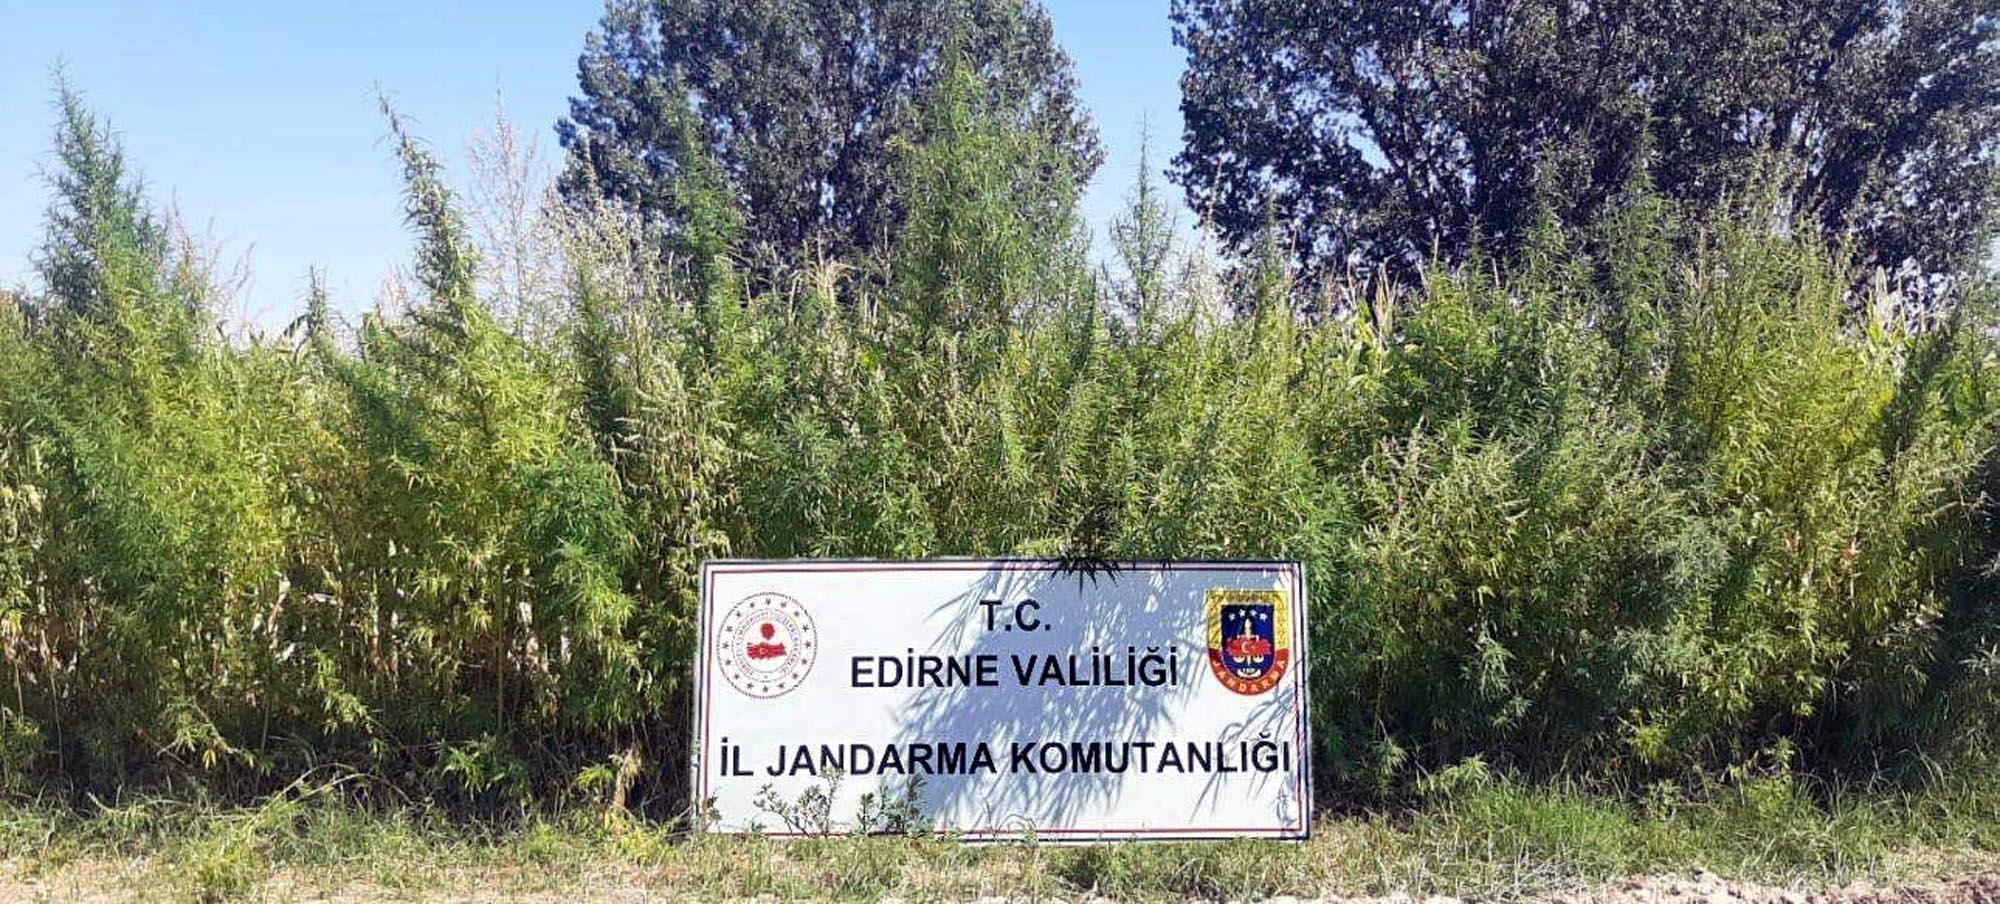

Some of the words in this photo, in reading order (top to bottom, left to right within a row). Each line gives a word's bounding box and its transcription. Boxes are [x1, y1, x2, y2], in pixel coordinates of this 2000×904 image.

[979, 599, 1051, 632] T.C.
[851, 647, 999, 688] EDİRNE
[1010, 646, 1177, 687] VALİLİĞİ
[721, 737, 754, 777] İL
[767, 742, 997, 777] JANDARMA
[1011, 732, 1290, 774] KOMUTANLIĞI
